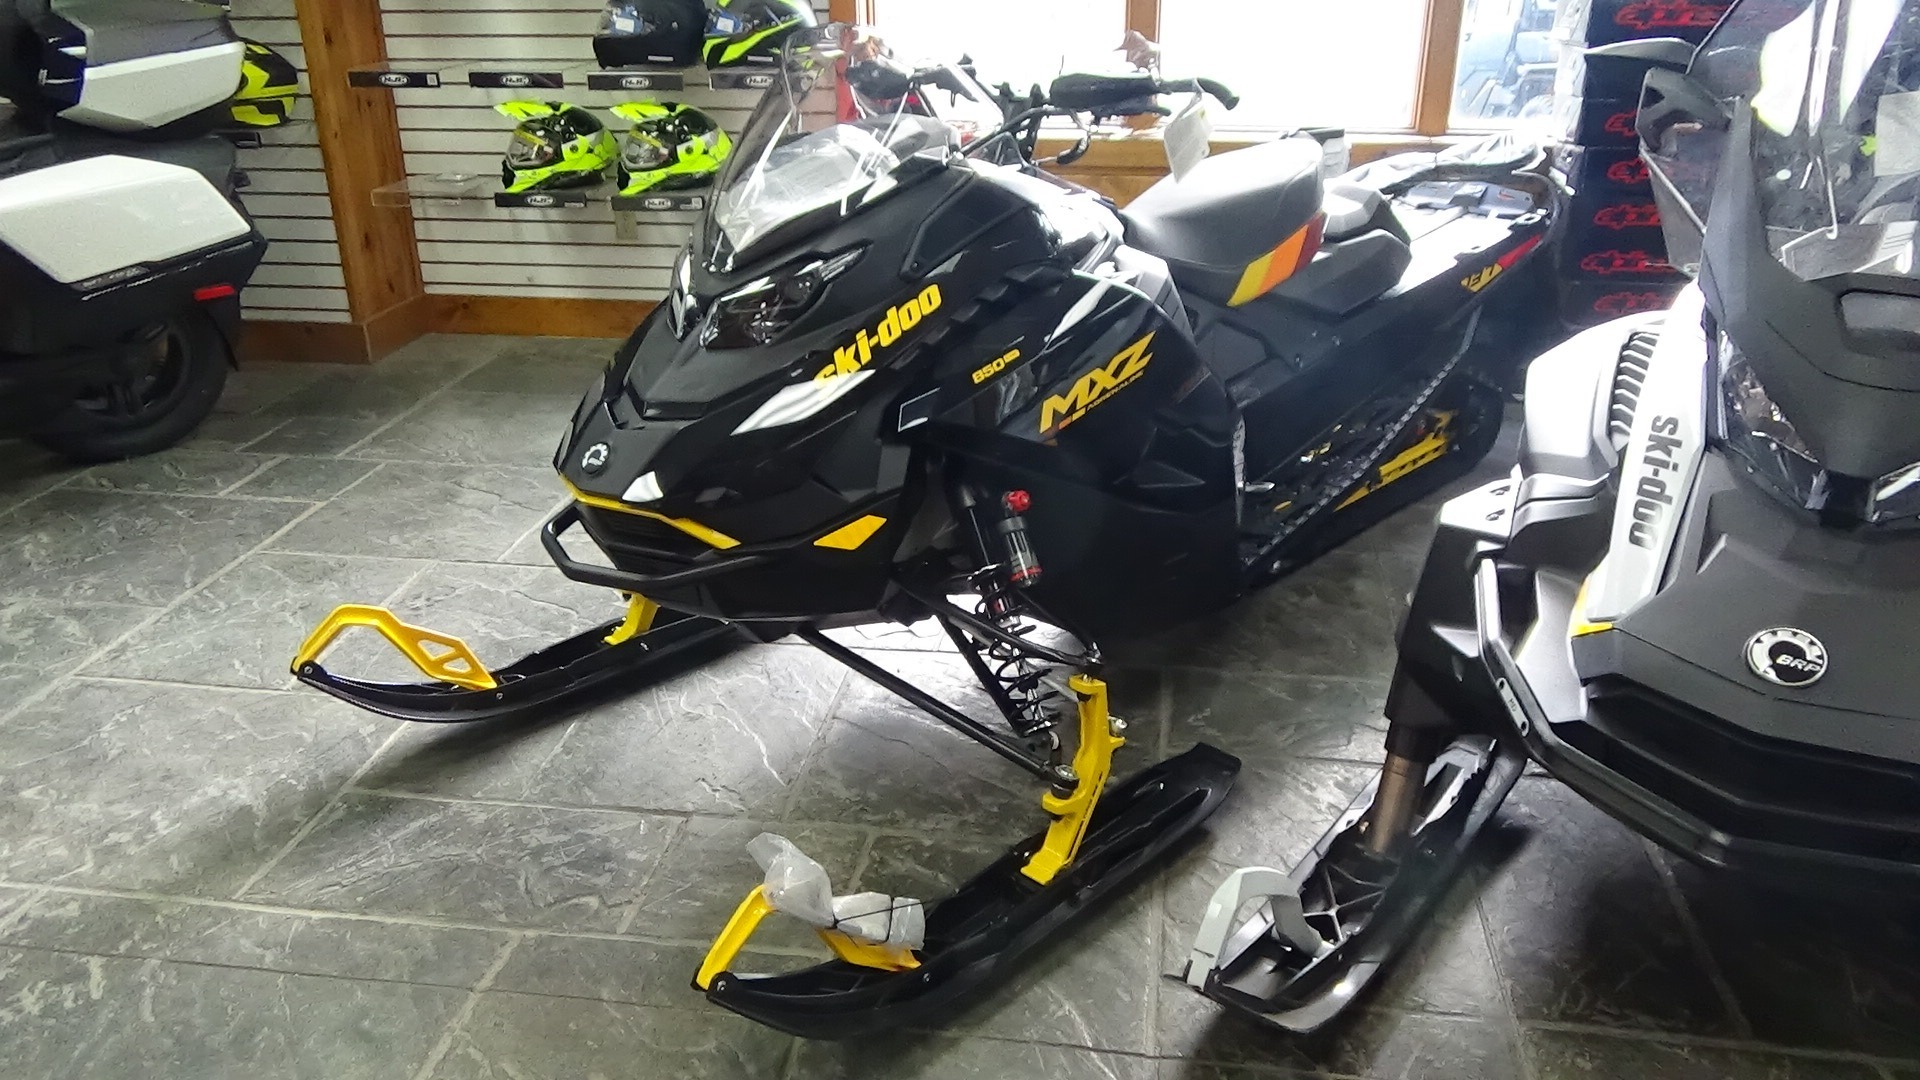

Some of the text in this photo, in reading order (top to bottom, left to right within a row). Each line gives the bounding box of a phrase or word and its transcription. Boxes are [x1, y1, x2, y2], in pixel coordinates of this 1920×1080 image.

[812, 284, 942, 391] ski-doo
[972, 357, 1005, 384] 850
[1040, 330, 1157, 434] MXZ
[1628, 415, 1683, 550] ski-doo
[1776, 654, 1822, 672] BRP
